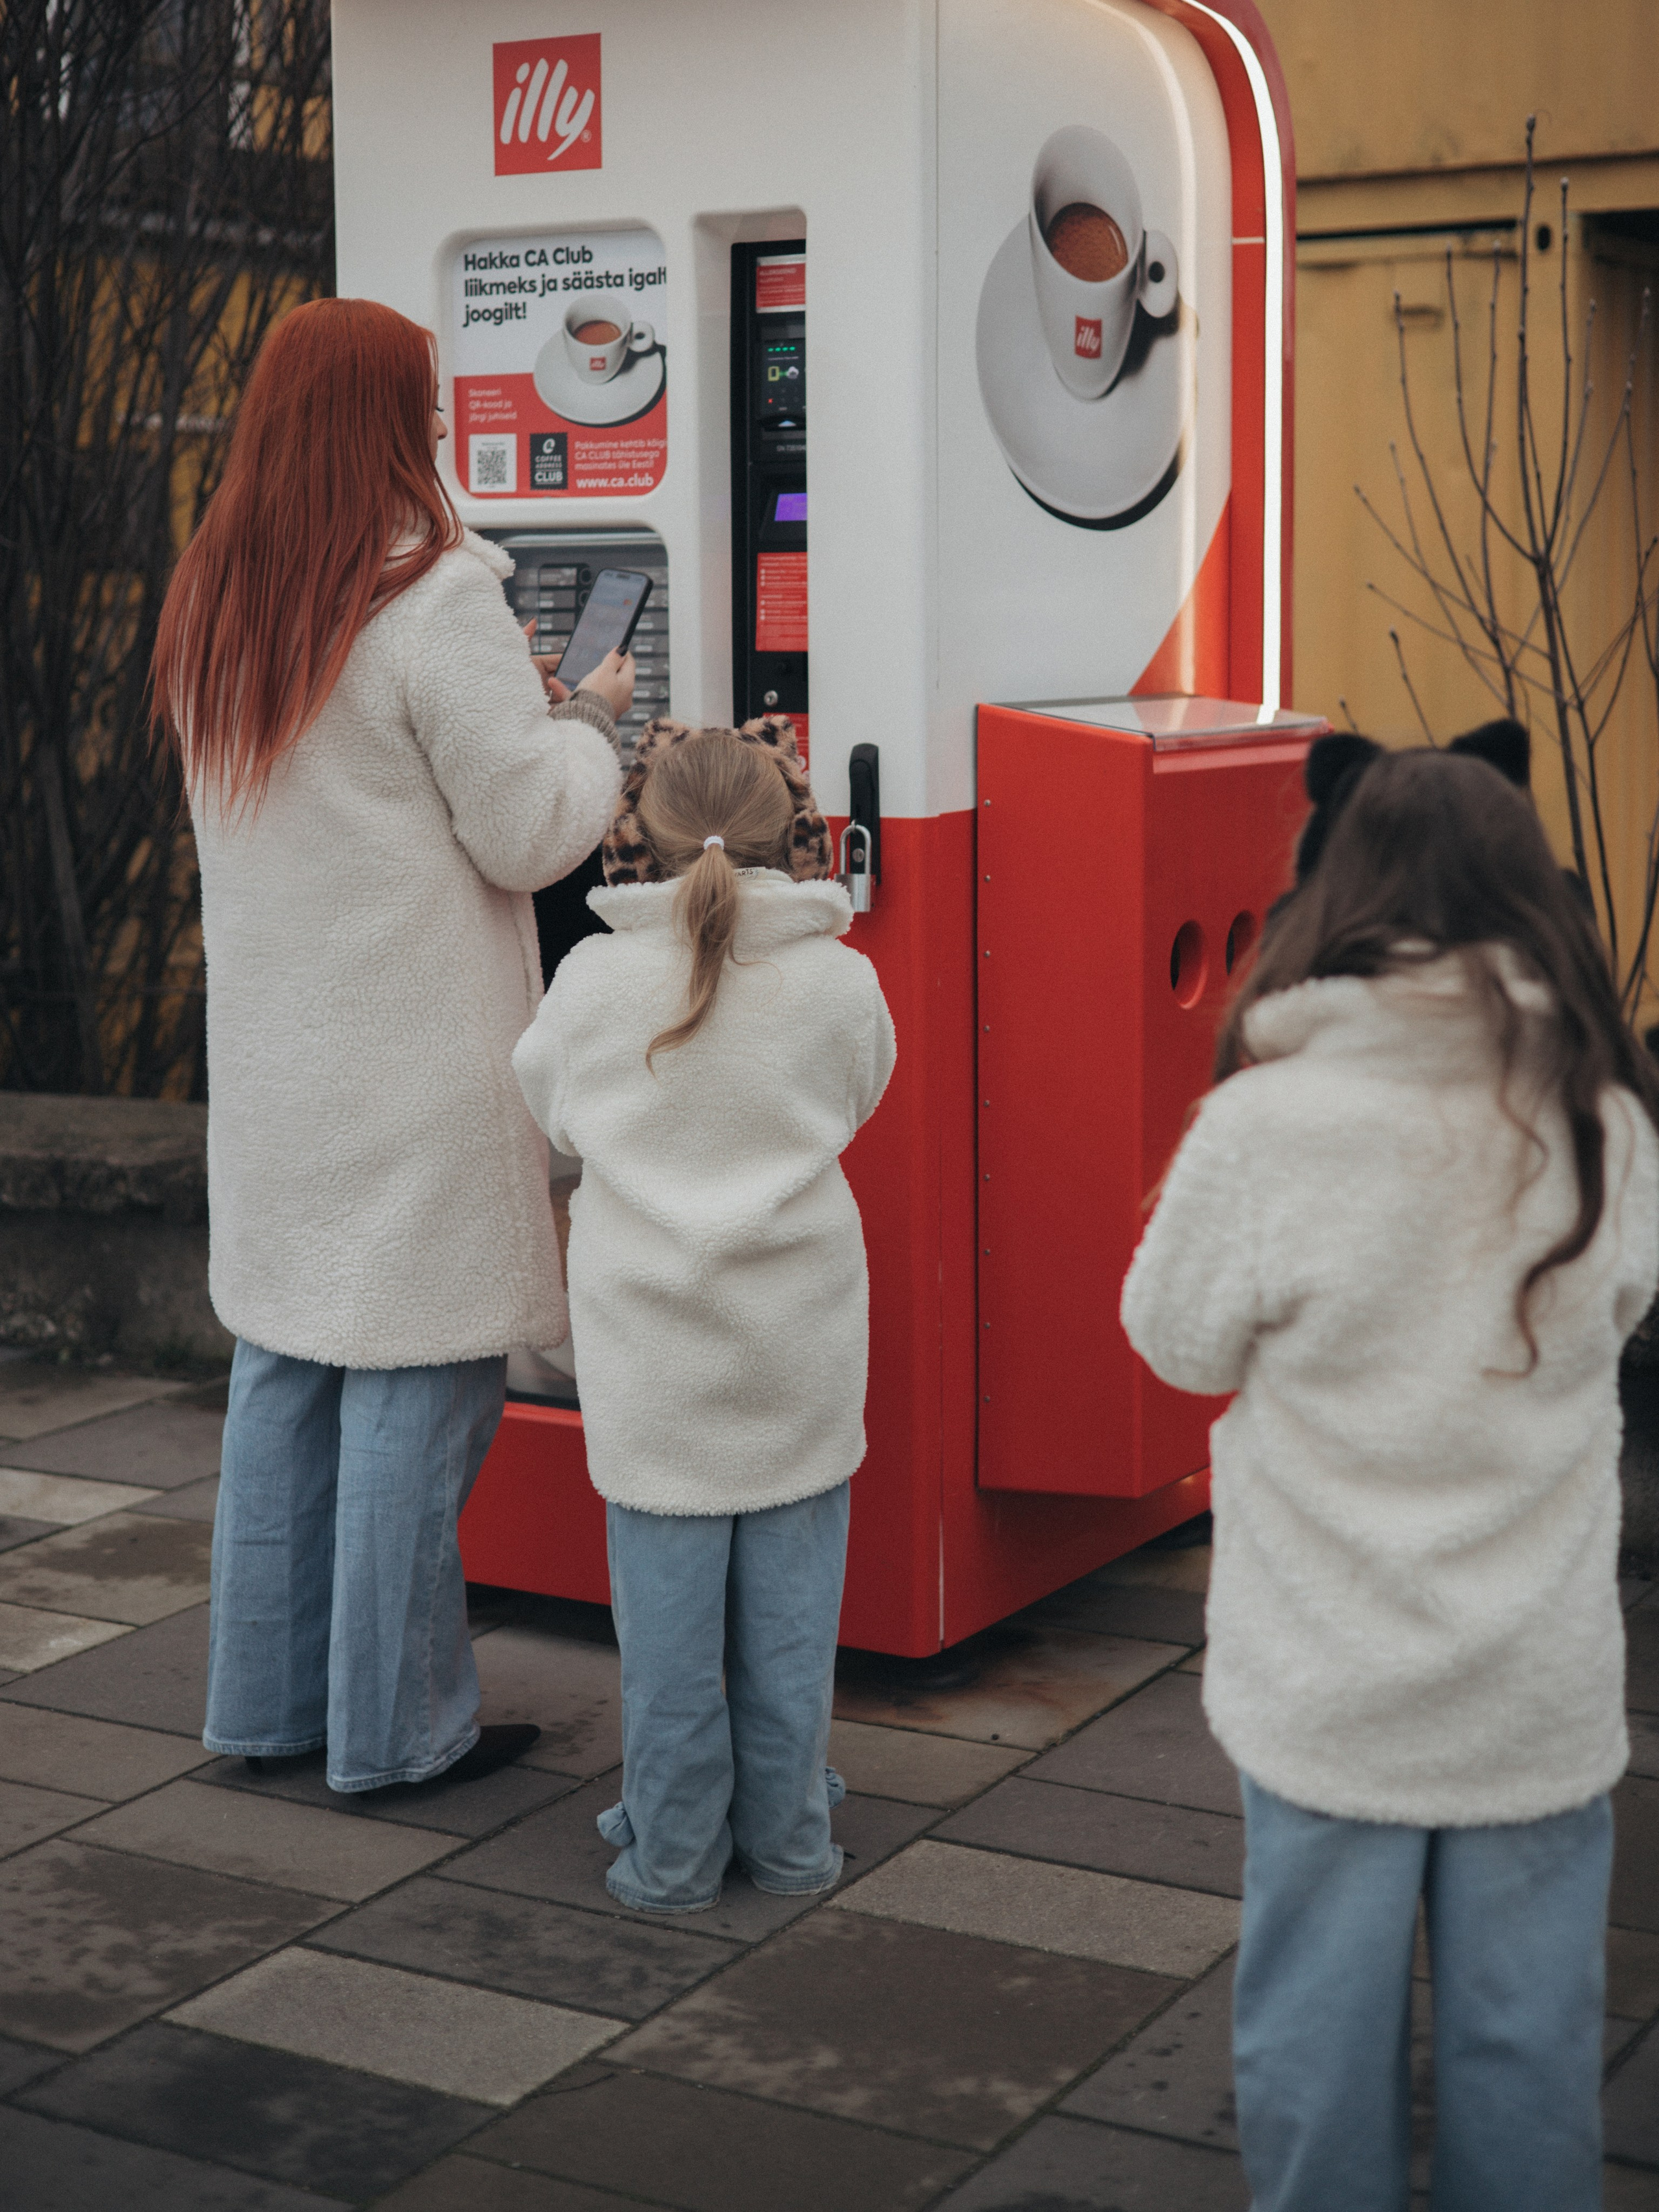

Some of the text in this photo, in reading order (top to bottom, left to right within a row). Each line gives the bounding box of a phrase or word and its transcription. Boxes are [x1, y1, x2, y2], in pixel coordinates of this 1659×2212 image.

[500, 58, 595, 160] illy
[464, 246, 593, 270] Hakka CA Club
[465, 276, 537, 296] liikmeks
[539, 274, 557, 297] ja
[563, 271, 624, 290] säästa
[463, 302, 526, 327] joogilt!
[574, 451, 586, 460] CA
[588, 450, 611, 460] CLUB
[535, 471, 563, 482] CLUB
[575, 472, 654, 489] www.ca.club
